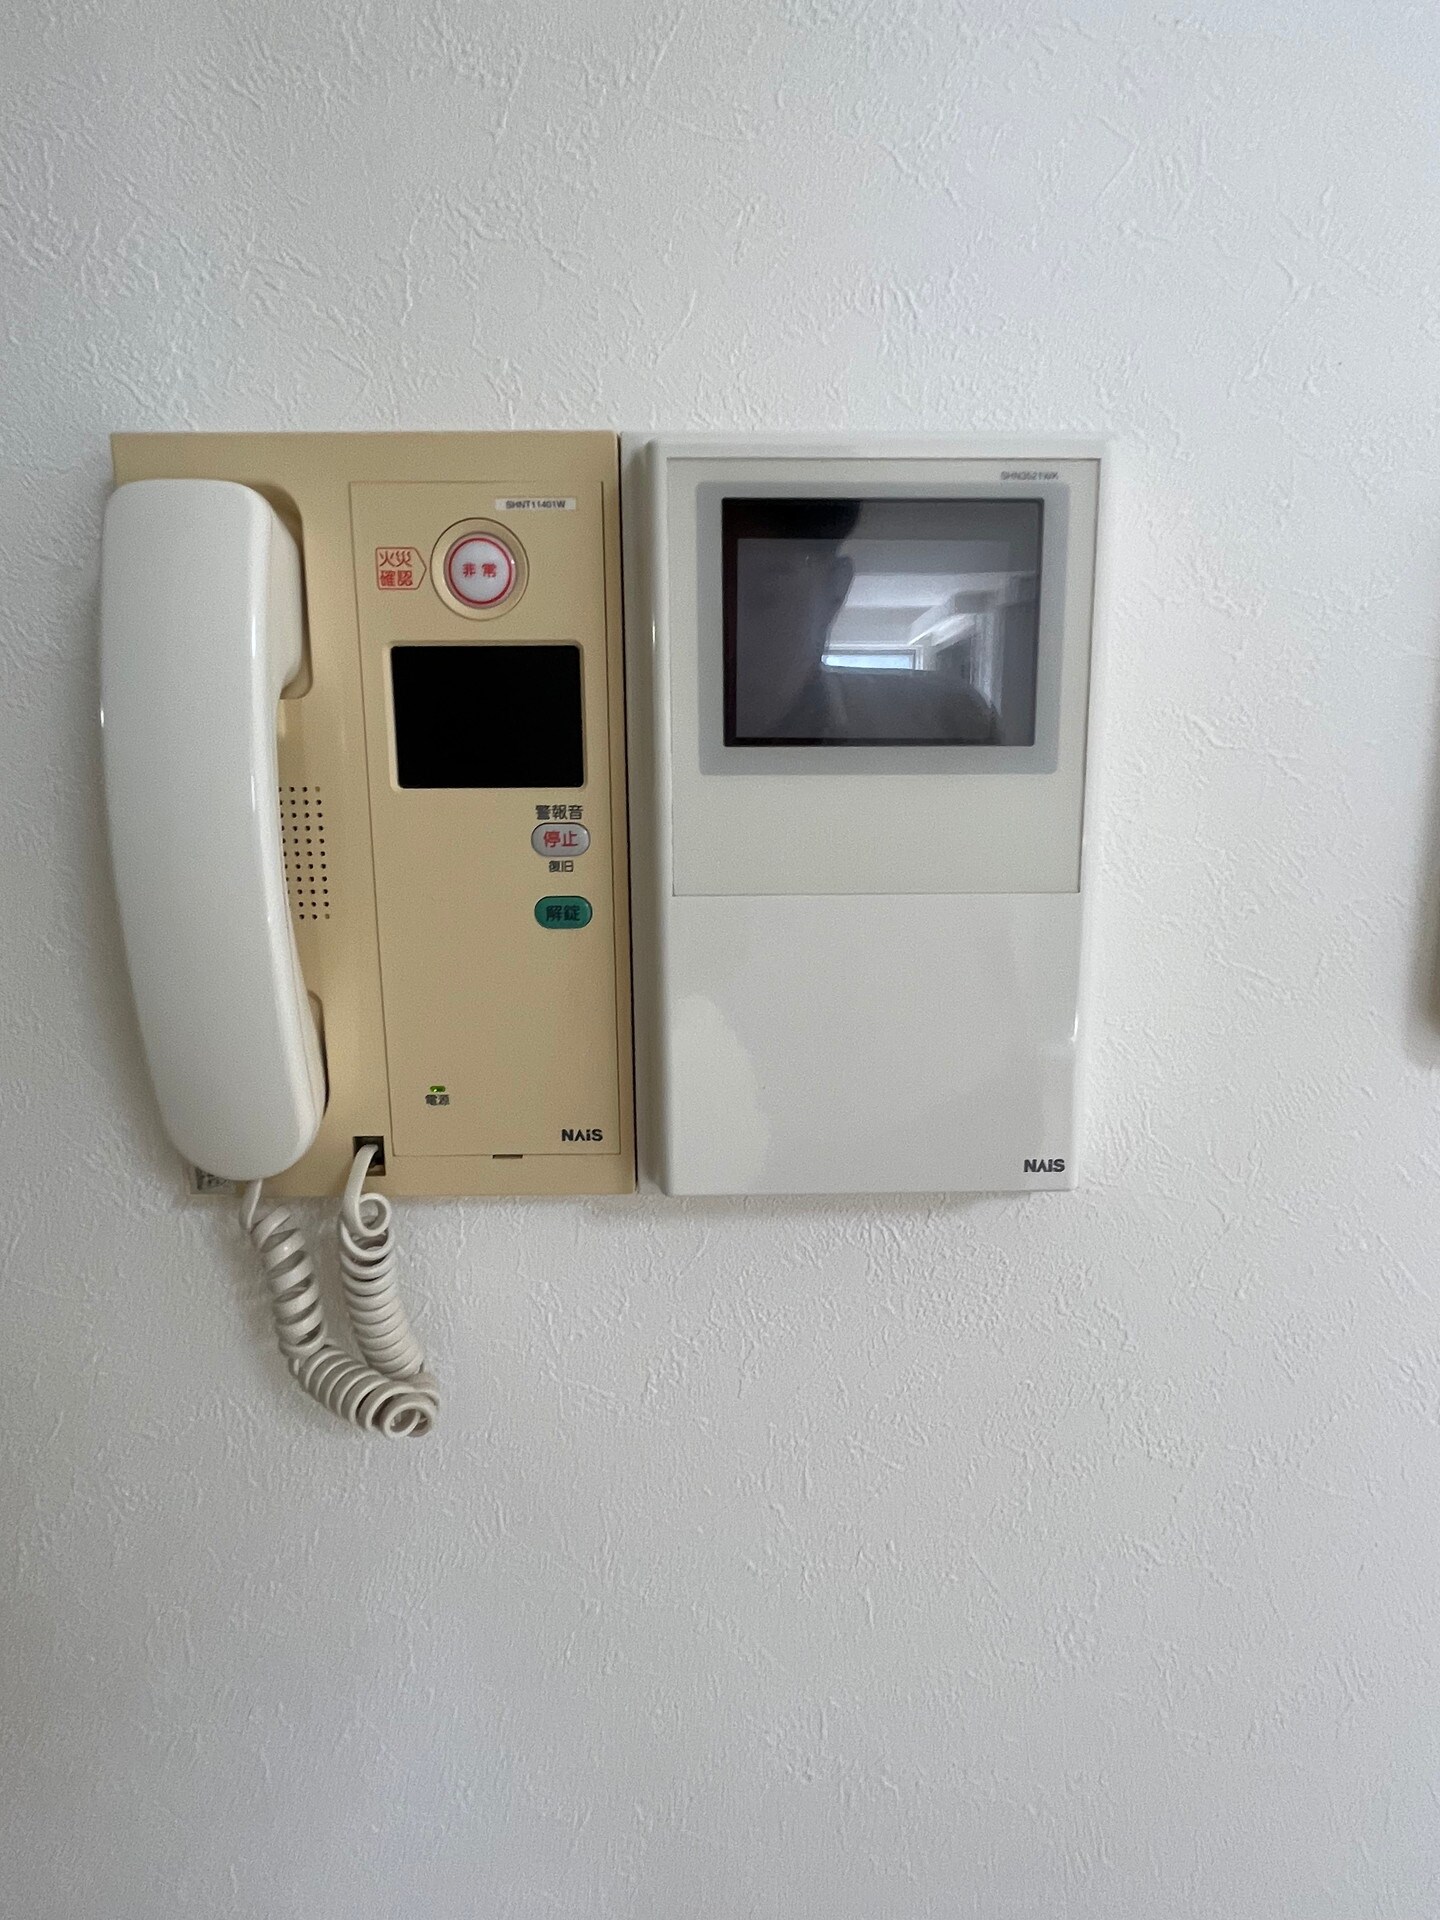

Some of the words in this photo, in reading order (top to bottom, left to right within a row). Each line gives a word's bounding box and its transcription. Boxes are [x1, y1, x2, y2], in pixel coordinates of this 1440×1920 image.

[379, 551, 412, 567] 火災
[463, 563, 497, 578] 非常
[380, 570, 413, 587] 確認
[535, 805, 583, 820] 警報音
[543, 831, 578, 848] 停止
[548, 860, 574, 872] 復旧
[546, 905, 580, 921] 解錠
[425, 1094, 450, 1106] 電源
